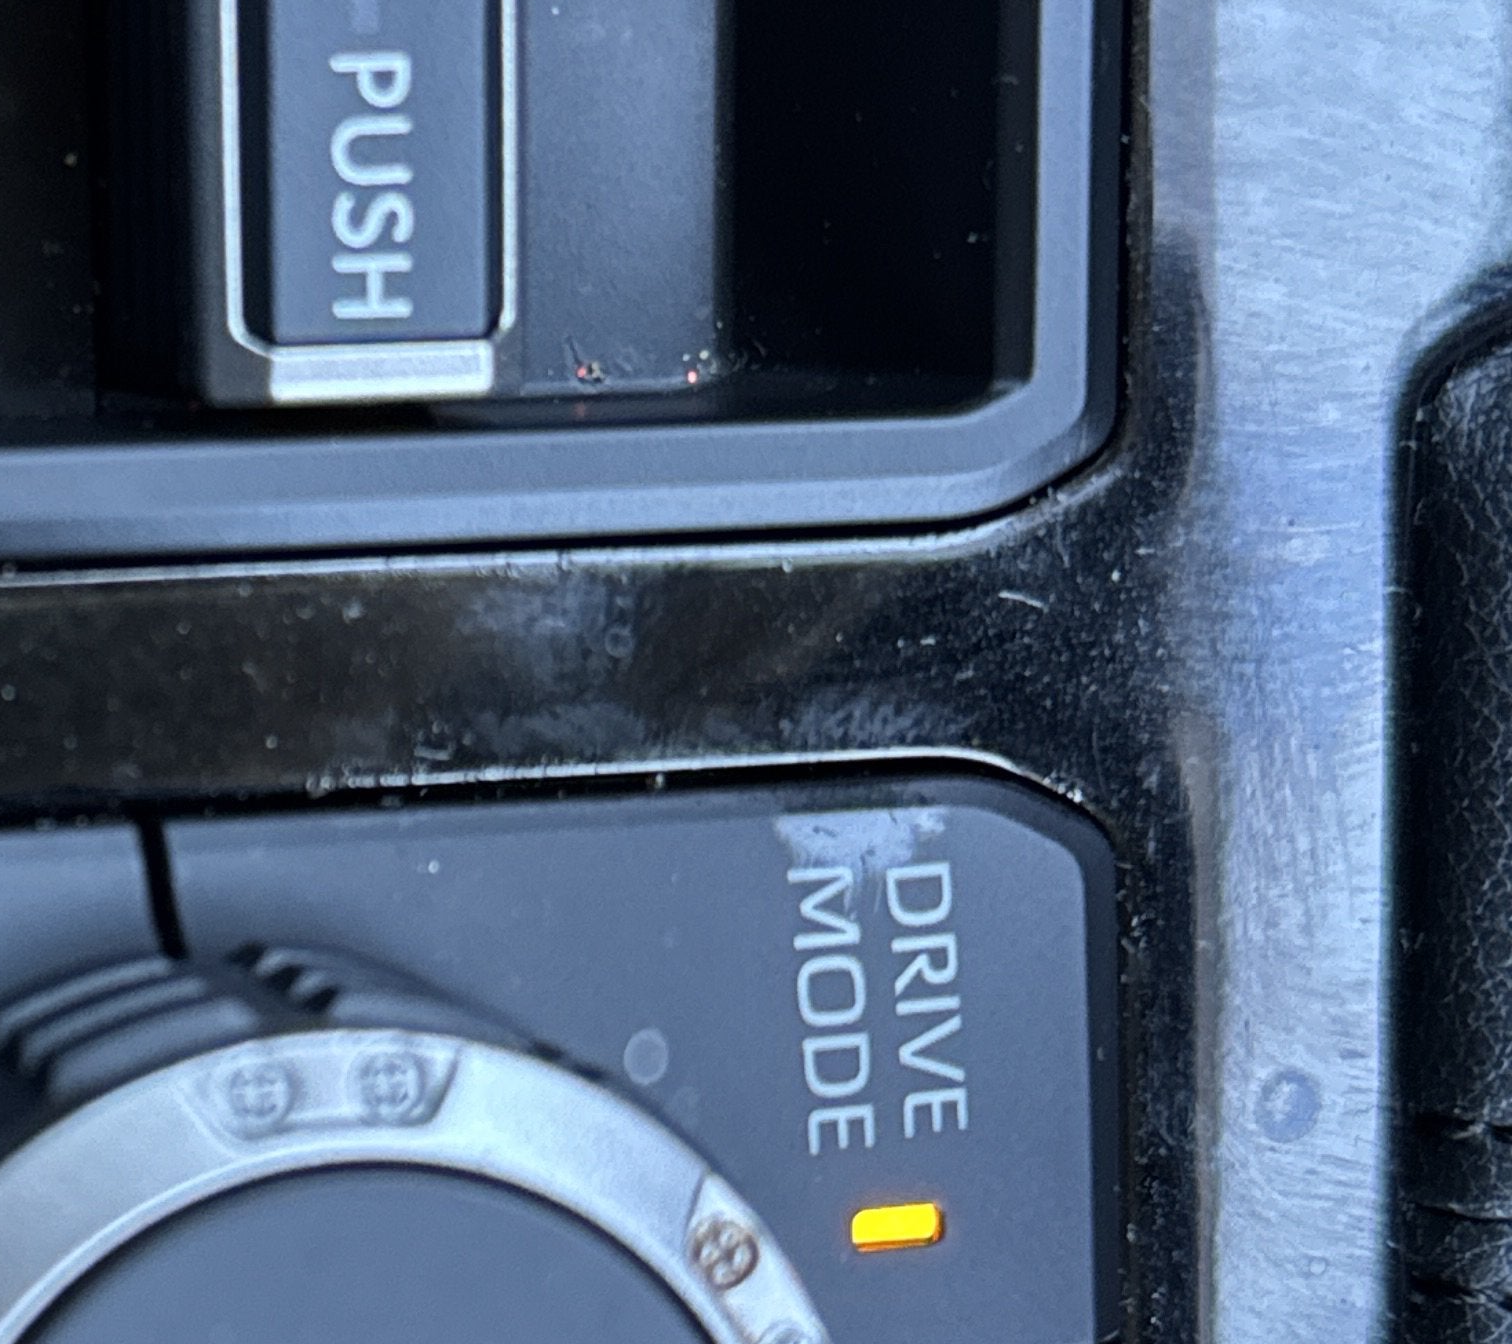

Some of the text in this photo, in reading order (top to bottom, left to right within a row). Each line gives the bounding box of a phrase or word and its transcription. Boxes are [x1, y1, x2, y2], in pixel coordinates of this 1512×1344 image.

[329, 52, 414, 319] PUSH
[787, 866, 876, 1155] MODE
[886, 862, 969, 1138] DRIVE
